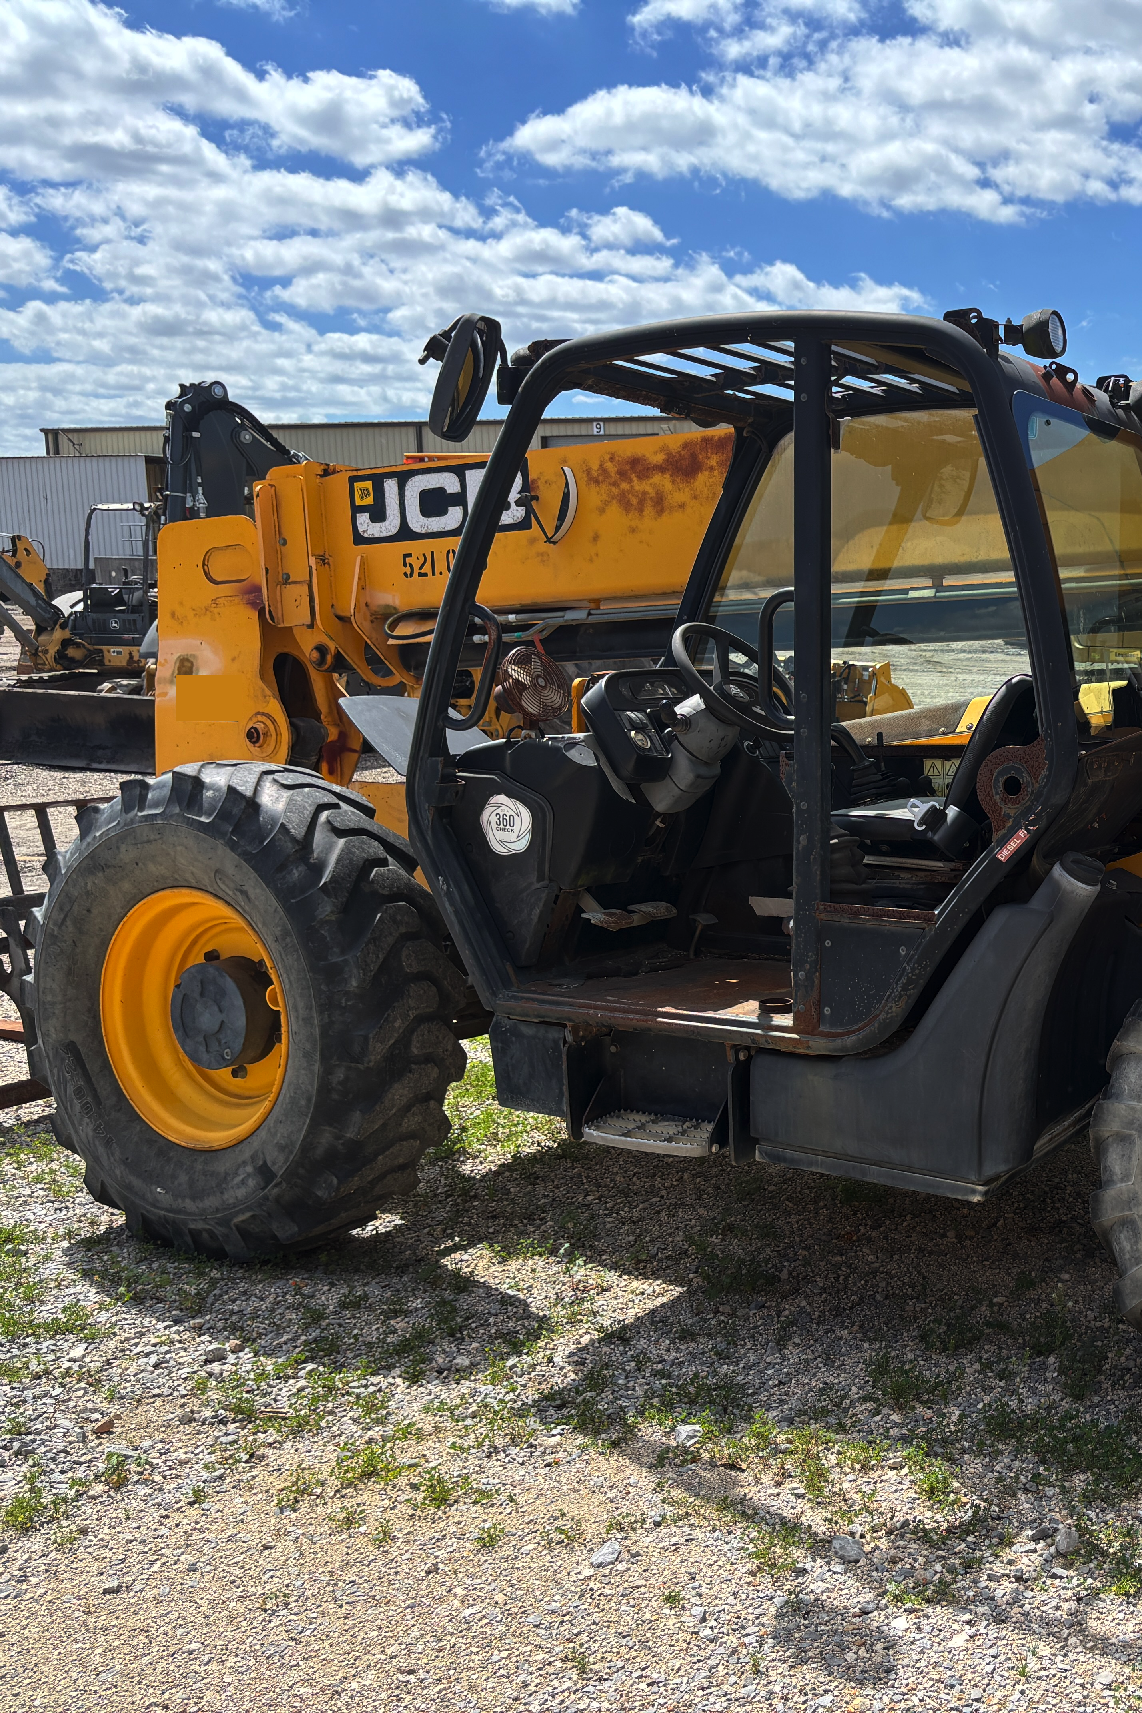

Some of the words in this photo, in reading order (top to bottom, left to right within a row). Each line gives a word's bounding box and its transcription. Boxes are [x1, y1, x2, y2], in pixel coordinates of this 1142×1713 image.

[595, 422, 602, 434] 9
[356, 468, 526, 538] JCB
[495, 812, 515, 828] 360
[997, 838, 1021, 861] DIESEL
